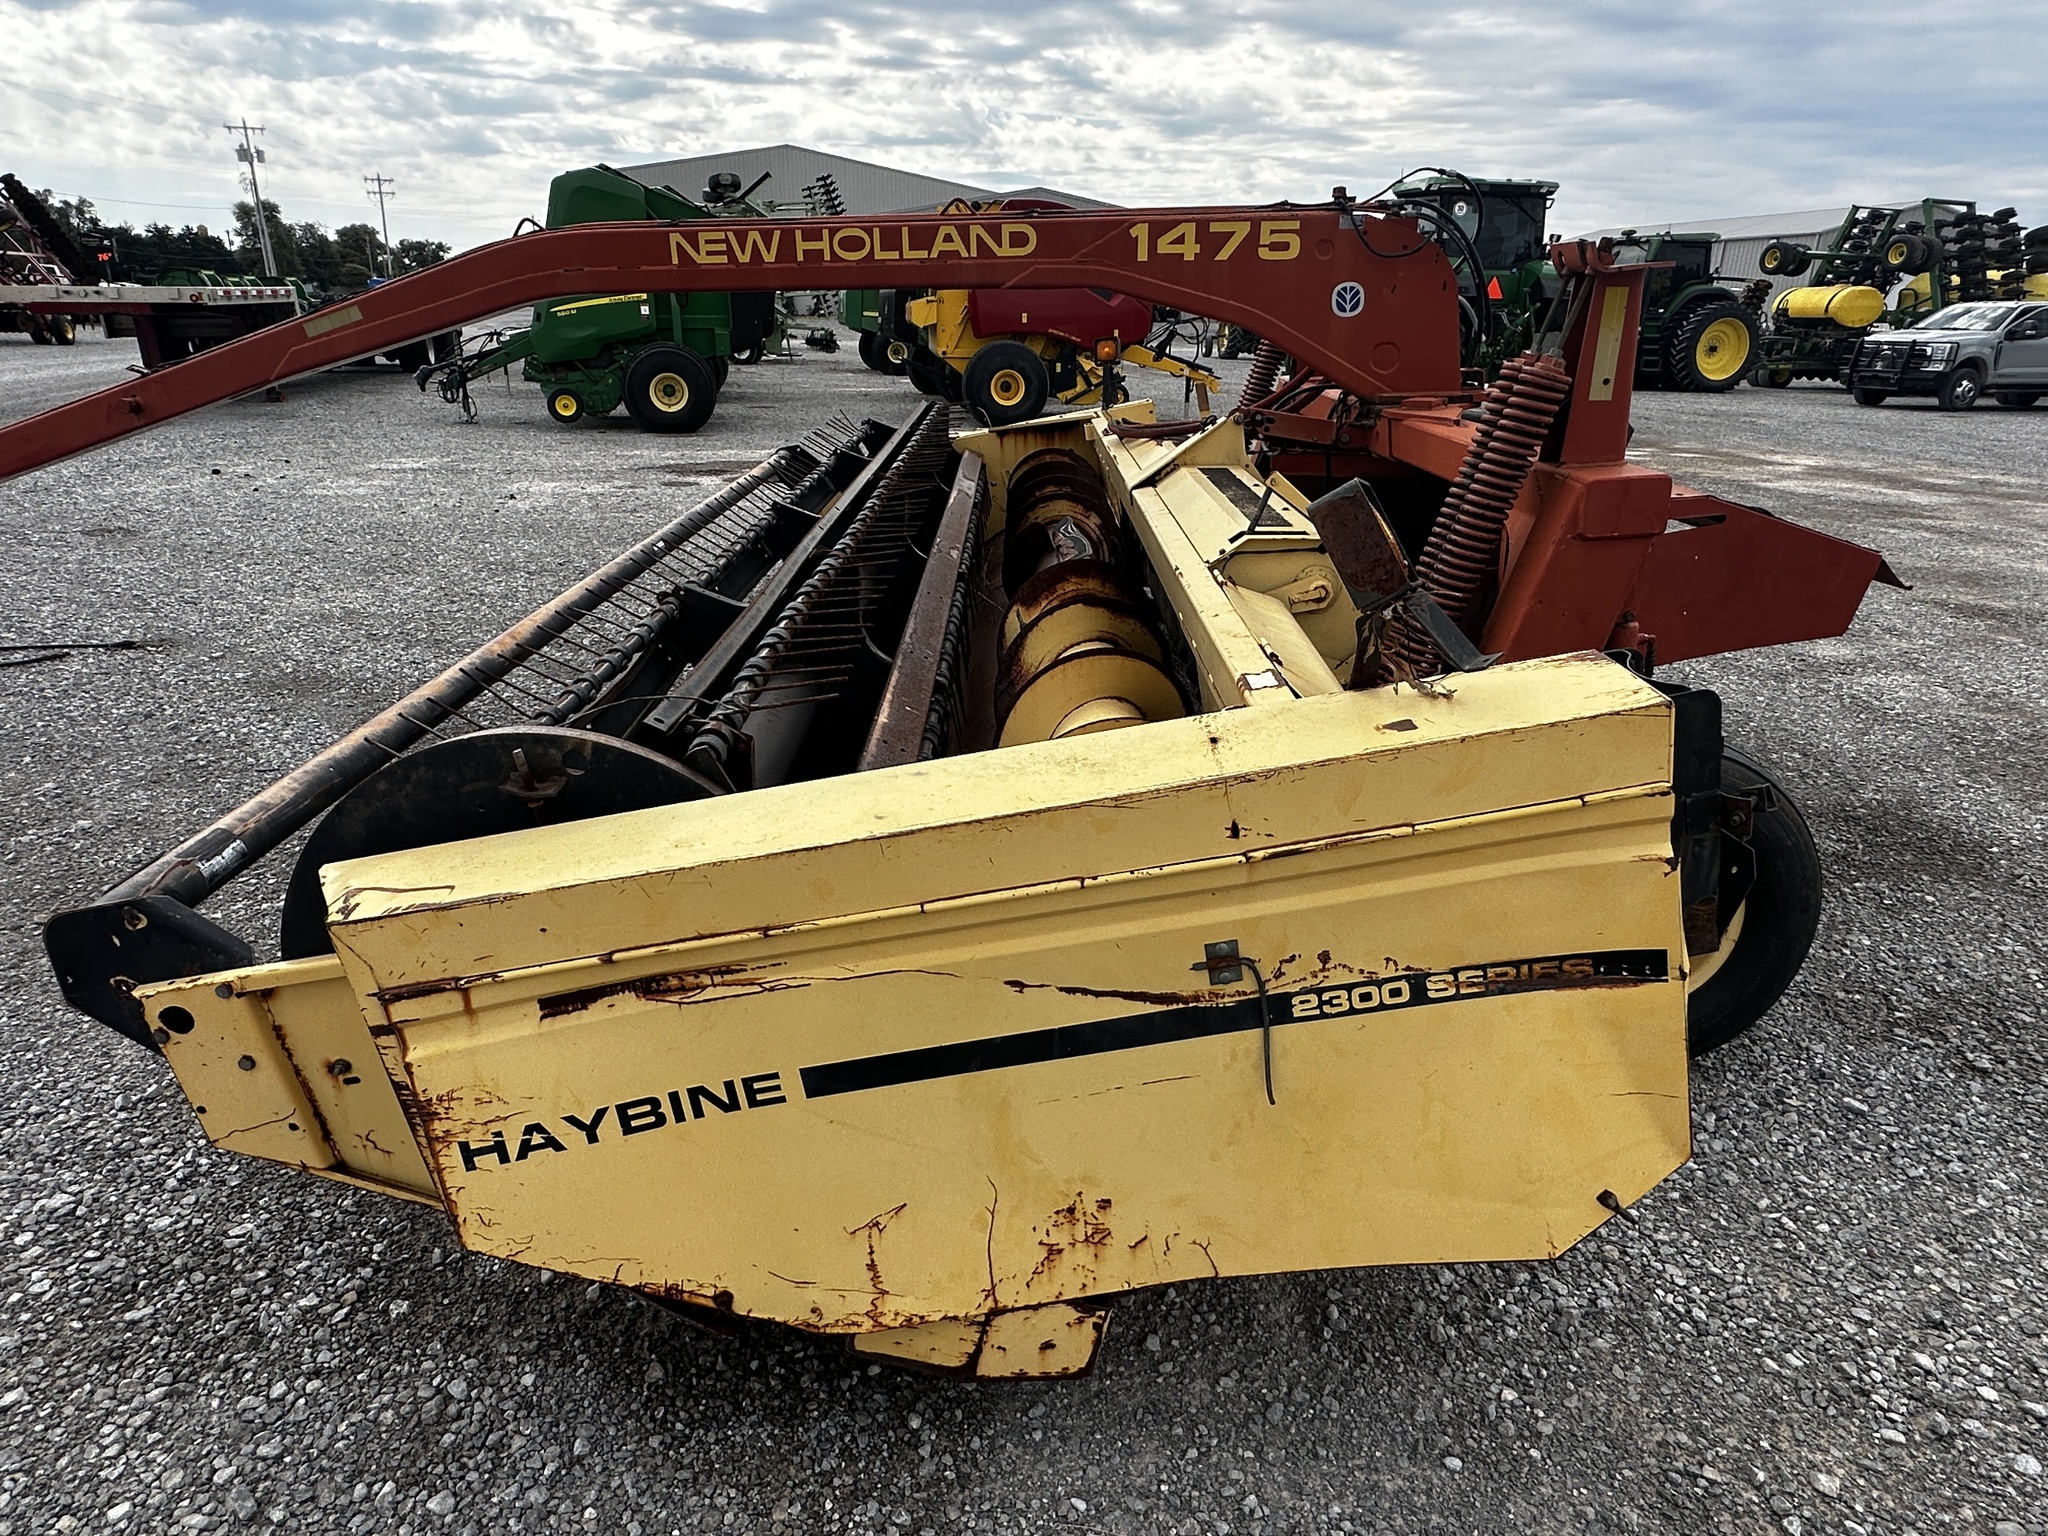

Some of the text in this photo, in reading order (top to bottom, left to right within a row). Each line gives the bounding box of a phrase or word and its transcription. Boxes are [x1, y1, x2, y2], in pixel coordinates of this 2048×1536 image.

[669, 223, 1037, 264] NEW HOLLAND
[1129, 220, 1301, 262] 1475
[1291, 980, 1411, 1018] 2300
[457, 1071, 788, 1173] HAYBINE
